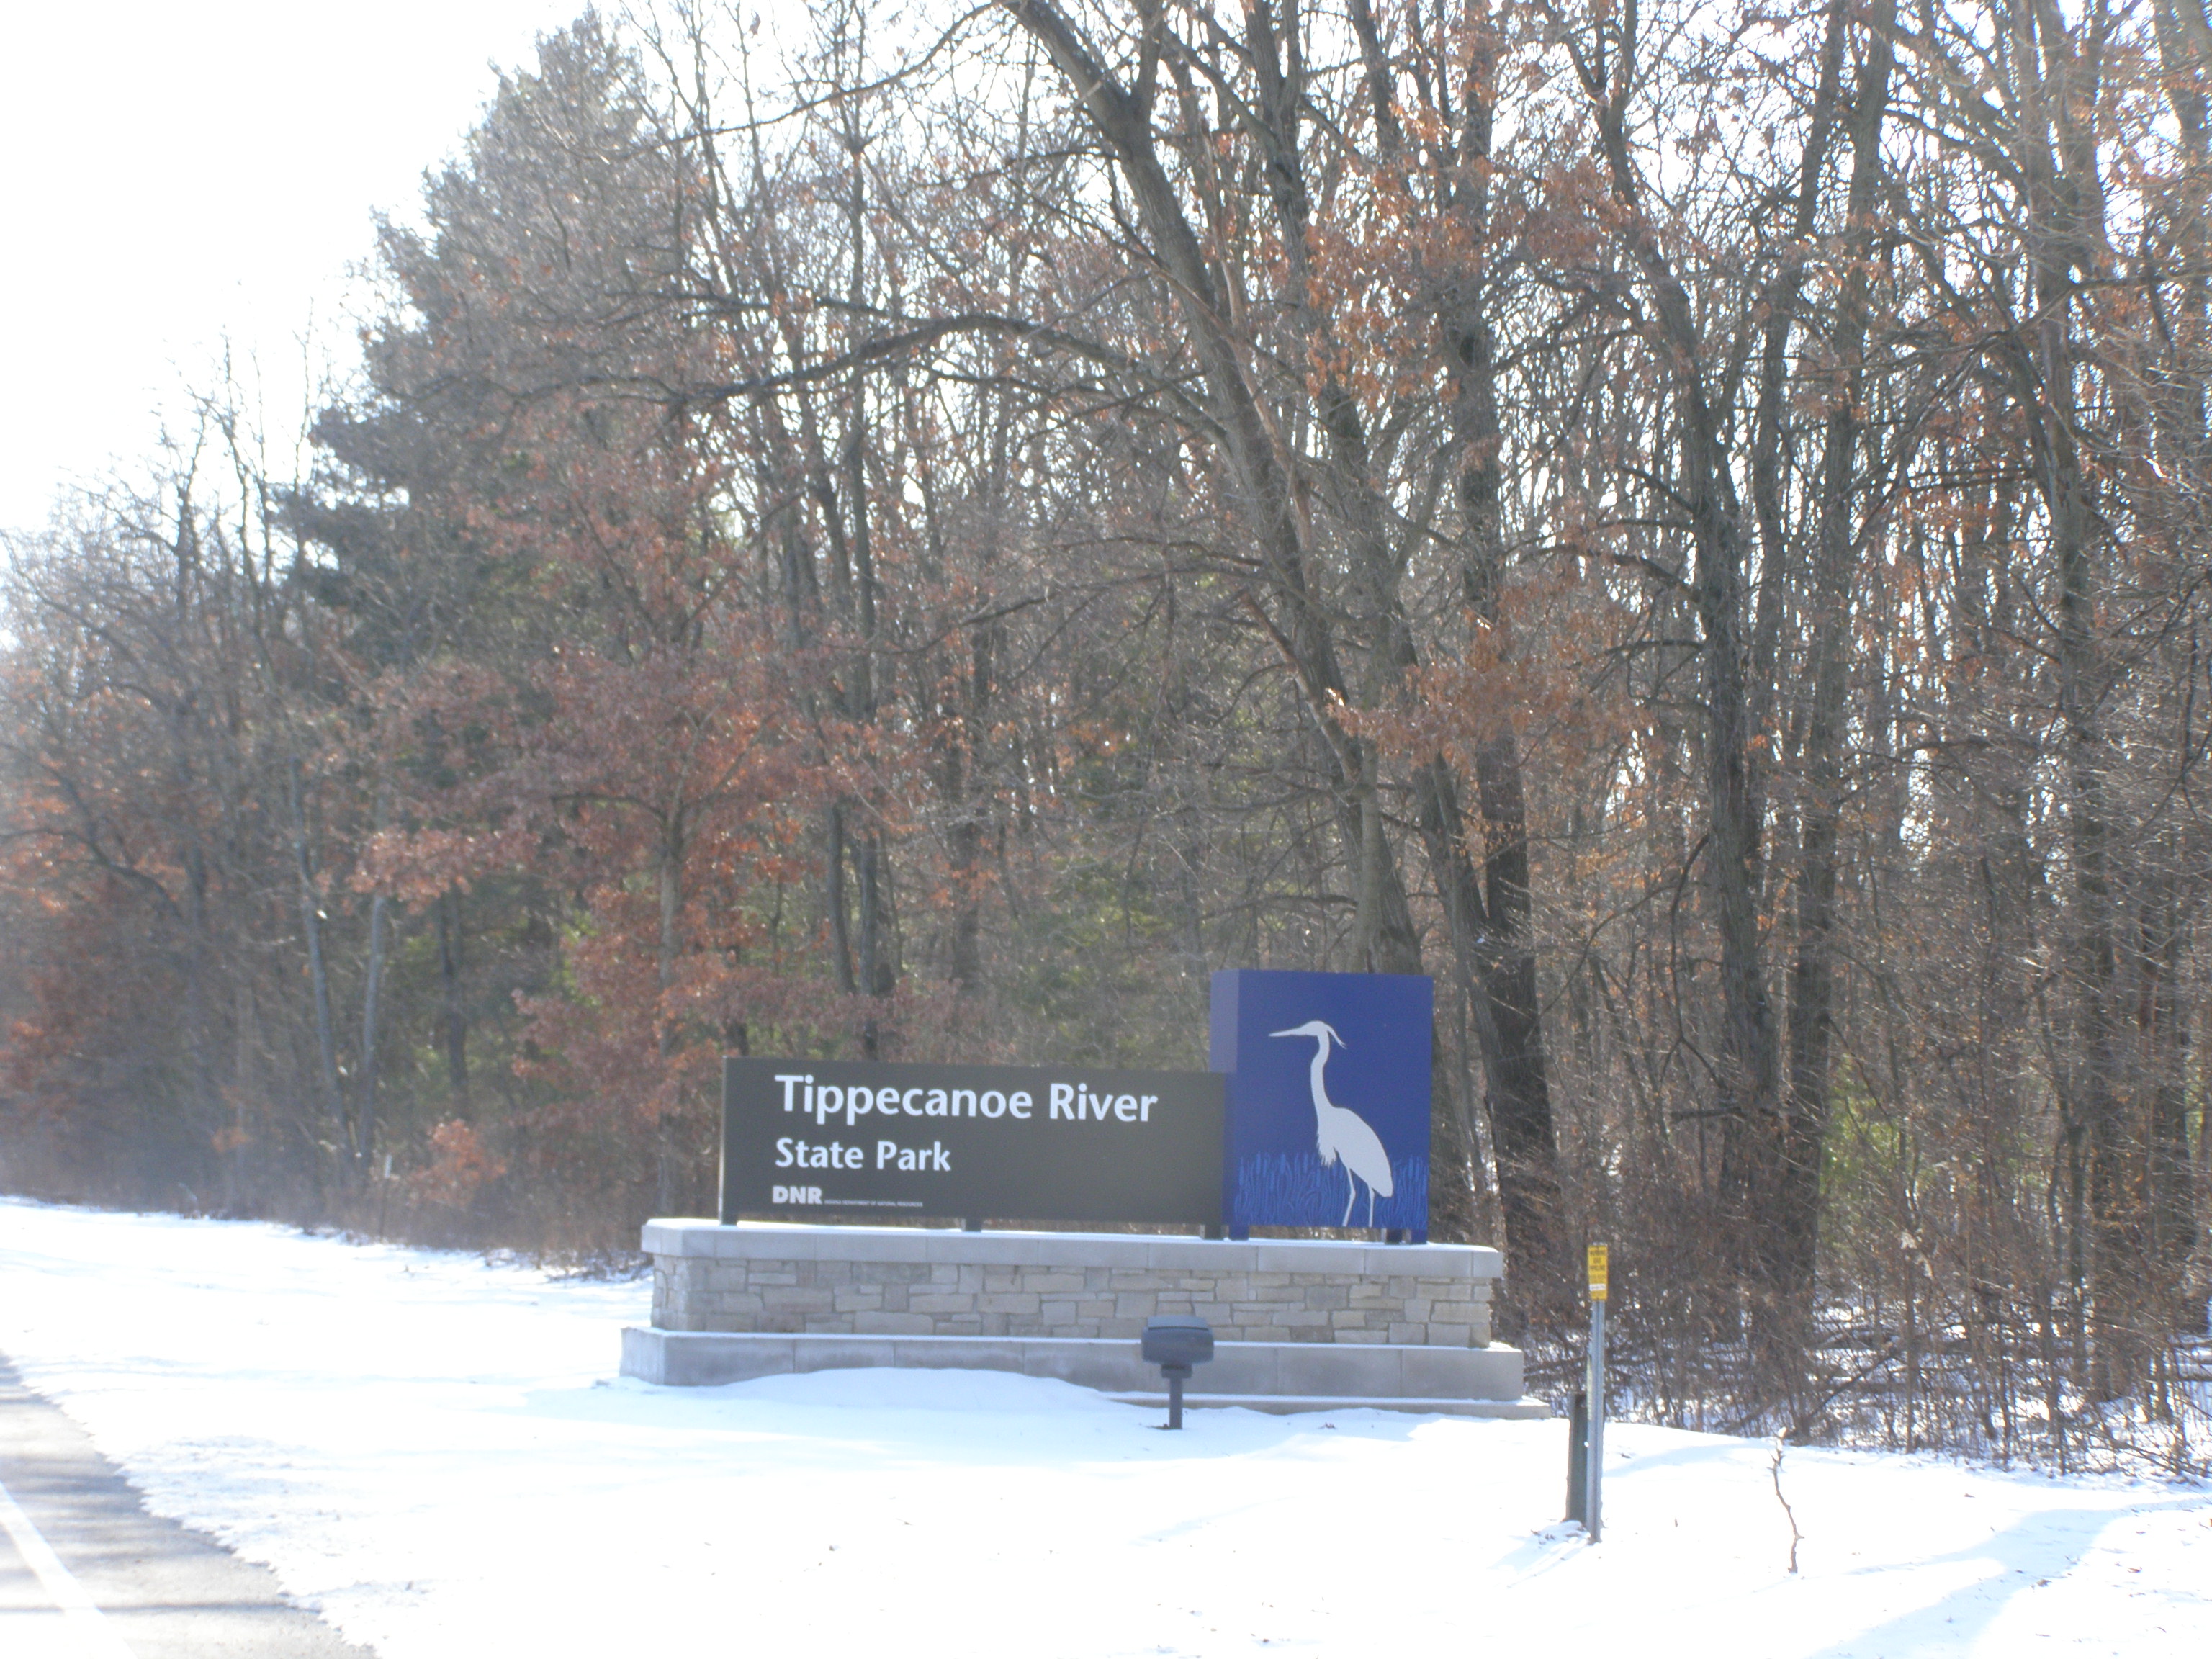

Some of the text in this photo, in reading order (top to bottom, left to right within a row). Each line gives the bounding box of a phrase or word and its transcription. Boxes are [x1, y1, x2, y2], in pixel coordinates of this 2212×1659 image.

[774, 1074, 1159, 1126] Tippecanoe River
[775, 1137, 951, 1172] State Park
[772, 1184, 823, 1205] DNR
